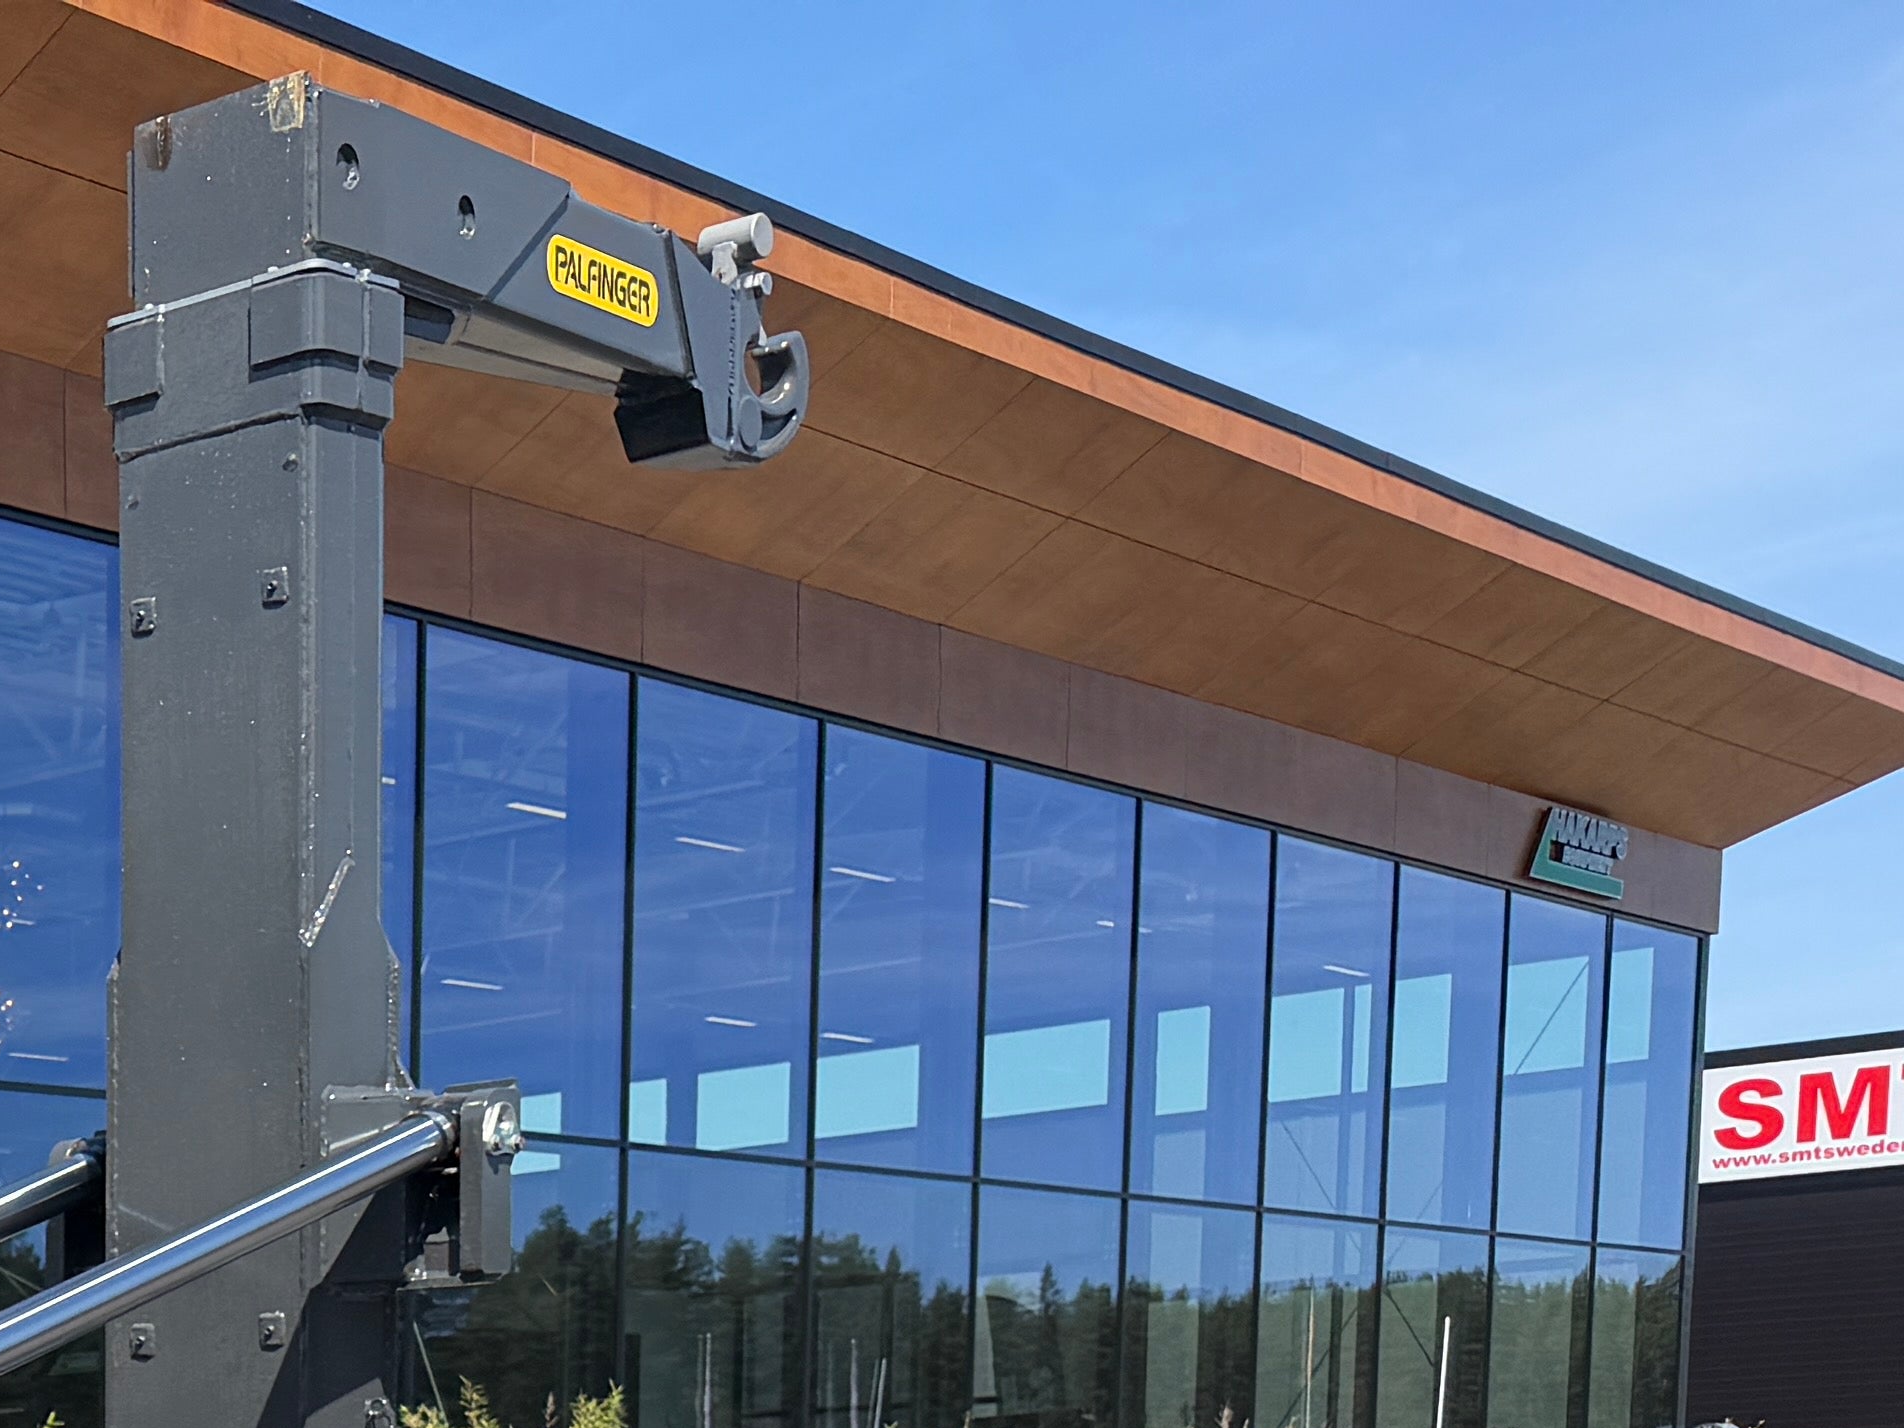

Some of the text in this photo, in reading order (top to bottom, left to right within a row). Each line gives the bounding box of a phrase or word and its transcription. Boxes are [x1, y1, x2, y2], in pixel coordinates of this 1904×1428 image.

[555, 243, 652, 317] PALFINGER
[1714, 1064, 1904, 1151] SM
[1712, 1139, 1904, 1169] www.smtswede
